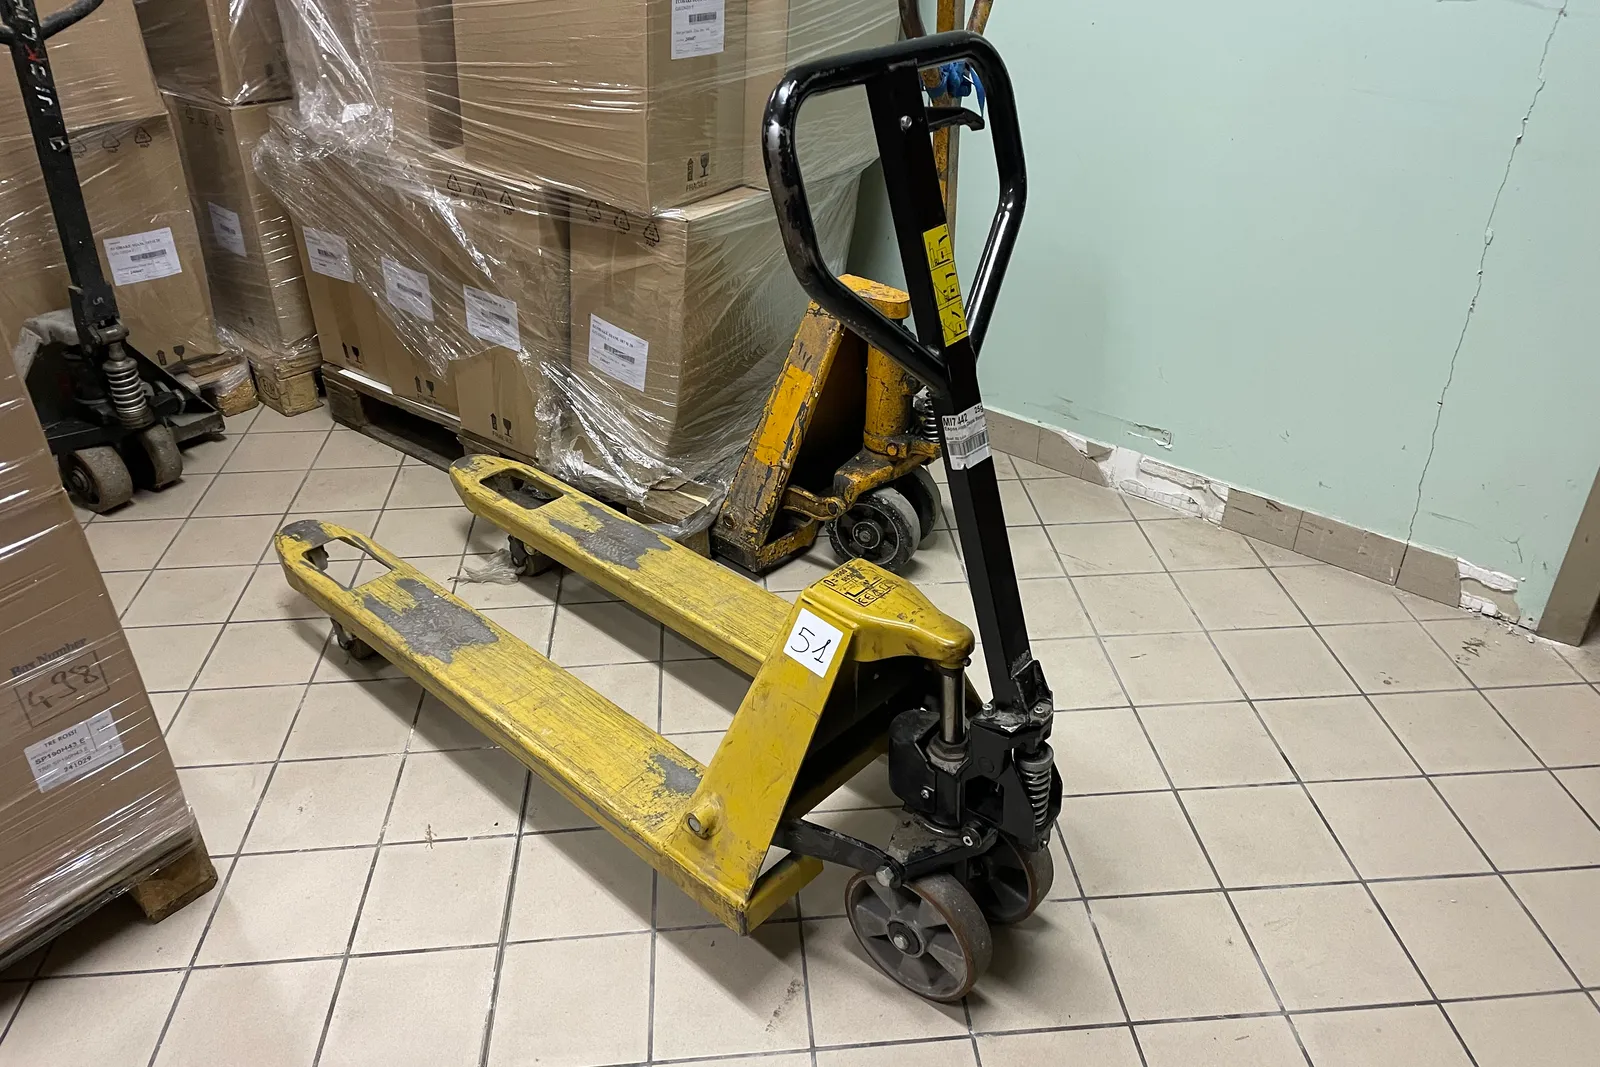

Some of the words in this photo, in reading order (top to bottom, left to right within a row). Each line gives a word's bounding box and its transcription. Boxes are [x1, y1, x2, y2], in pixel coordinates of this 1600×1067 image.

[9, 661, 36, 678] Box
[36, 638, 87, 663] Number
[790, 626, 832, 664] 51
[28, 665, 99, 708] 498
